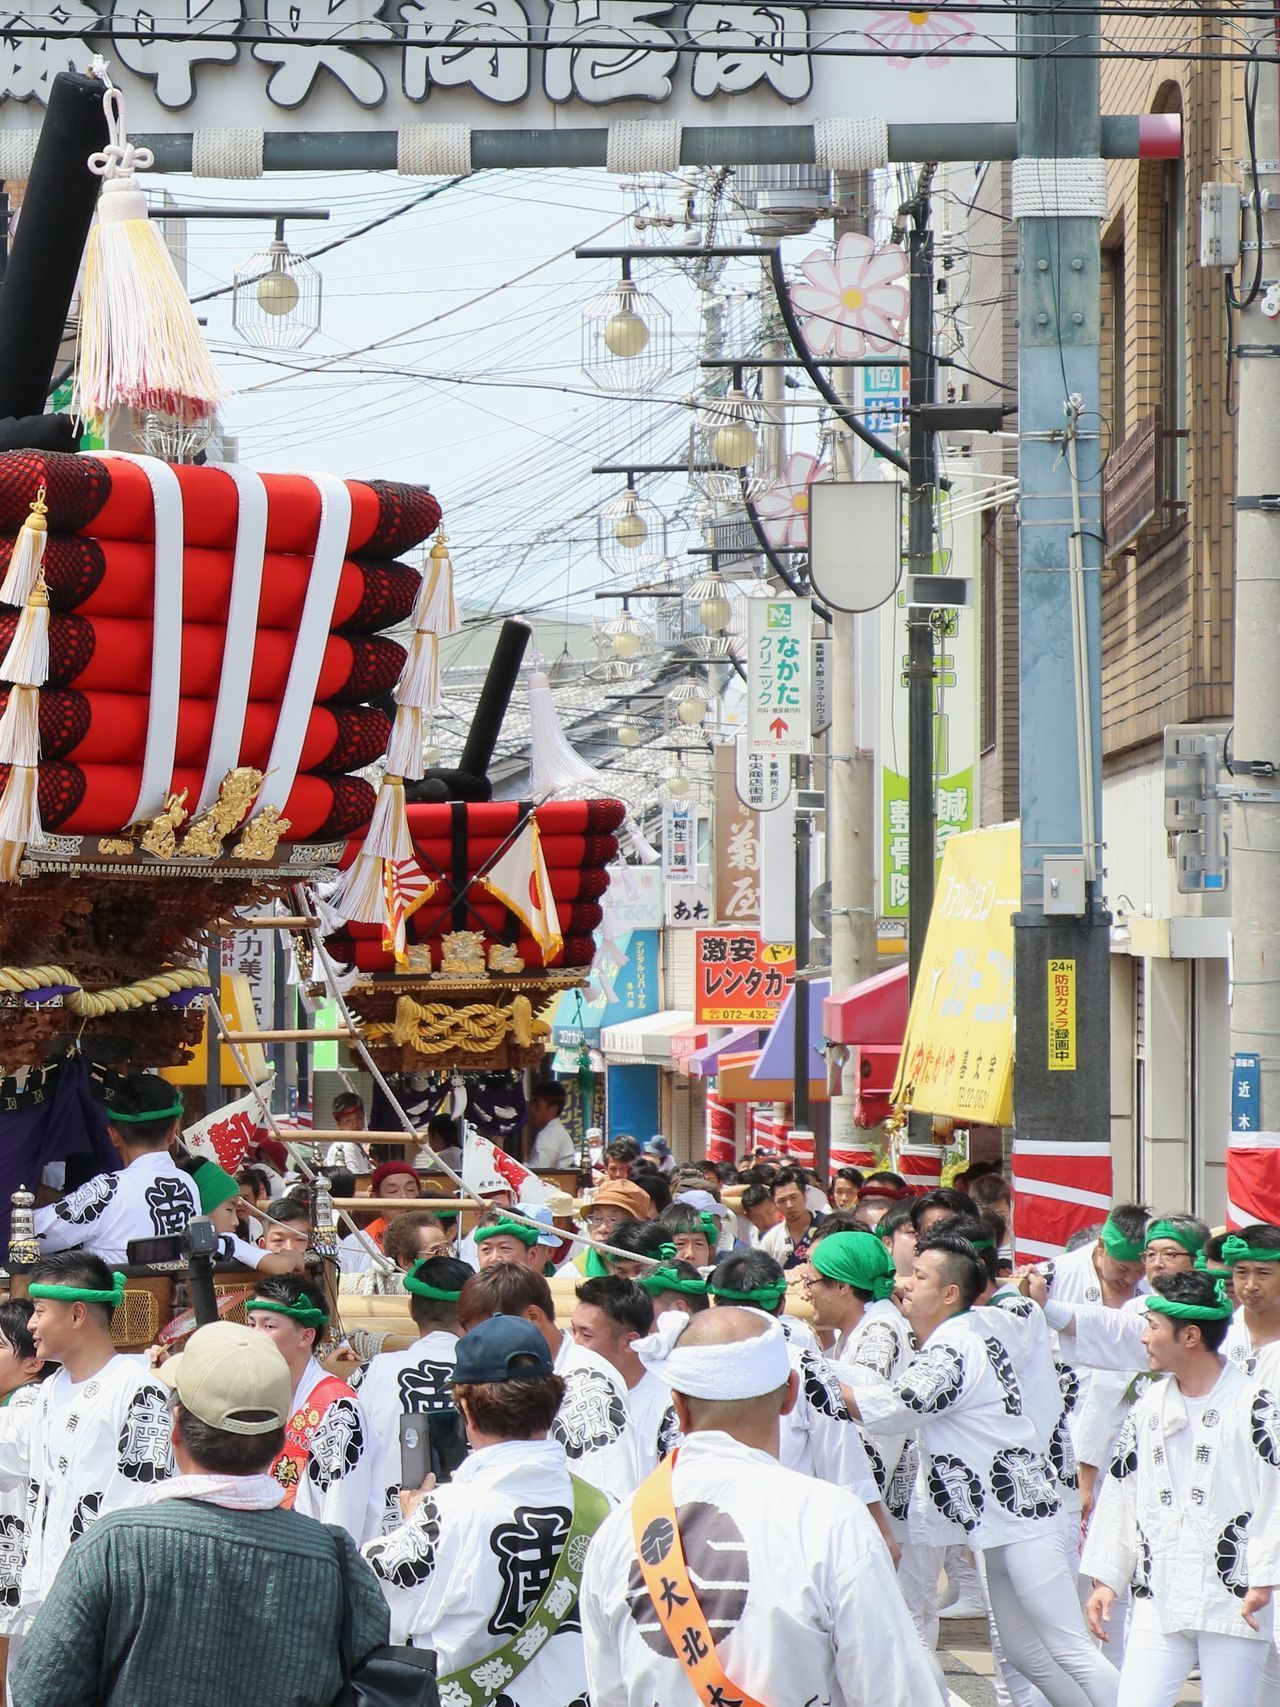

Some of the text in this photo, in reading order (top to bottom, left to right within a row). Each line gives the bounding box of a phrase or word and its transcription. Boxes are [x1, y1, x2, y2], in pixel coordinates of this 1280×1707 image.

[758, 635, 773, 706] クリニック
[777, 635, 800, 705] なかた
[702, 937, 756, 963] 激安
[1051, 961, 1073, 971] 24H
[1054, 973, 1070, 1061] 防犯カメラ録画中
[1238, 1080, 1251, 1131] 近木
